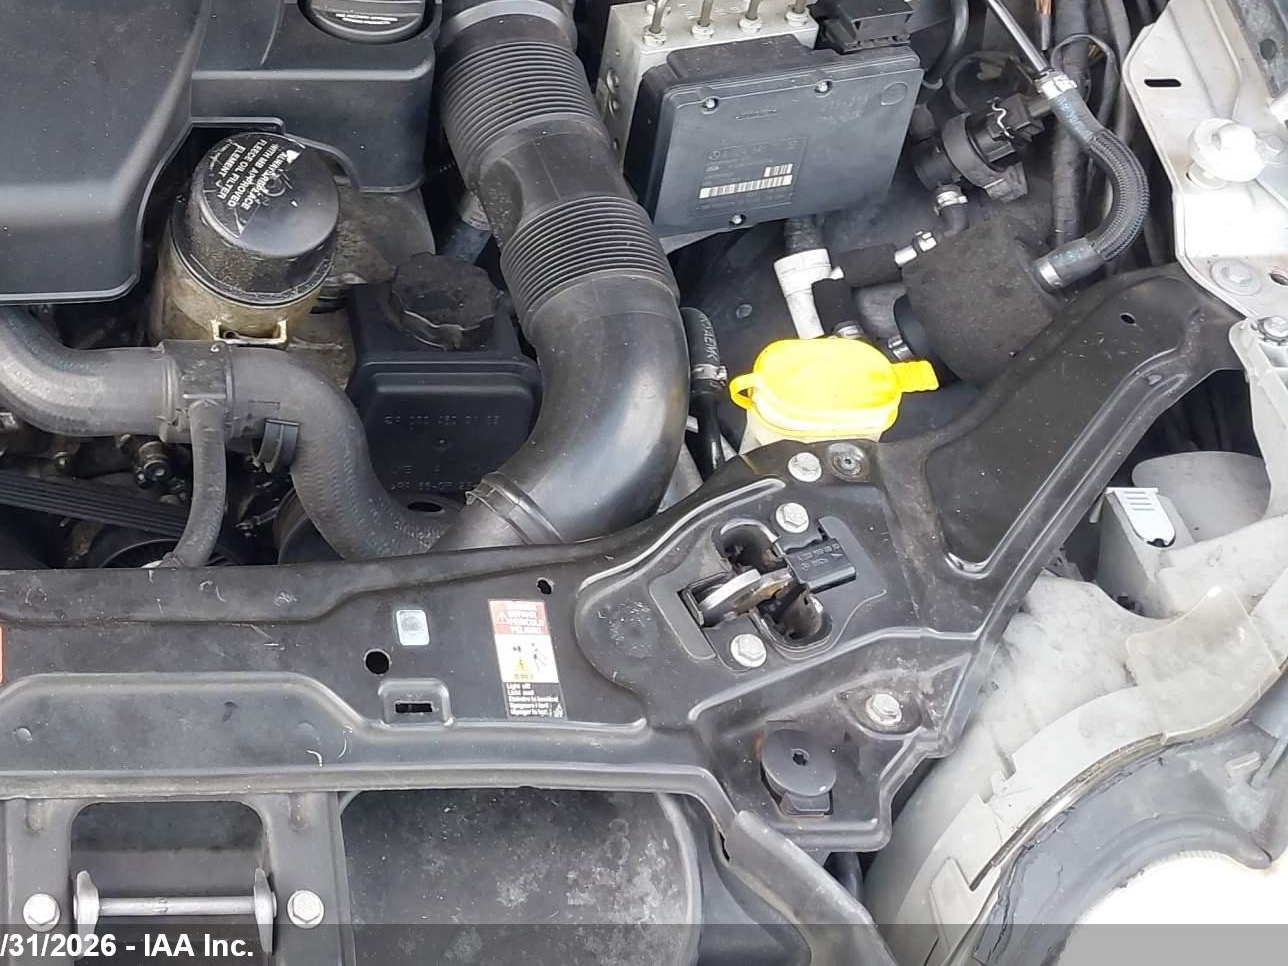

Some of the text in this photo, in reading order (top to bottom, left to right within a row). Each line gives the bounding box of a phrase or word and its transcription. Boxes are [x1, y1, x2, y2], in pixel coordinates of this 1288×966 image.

[217, 138, 268, 200] FLEECE OIL FILTER
[218, 145, 246, 177] ELEMENT
[227, 167, 259, 207] APPROVED
